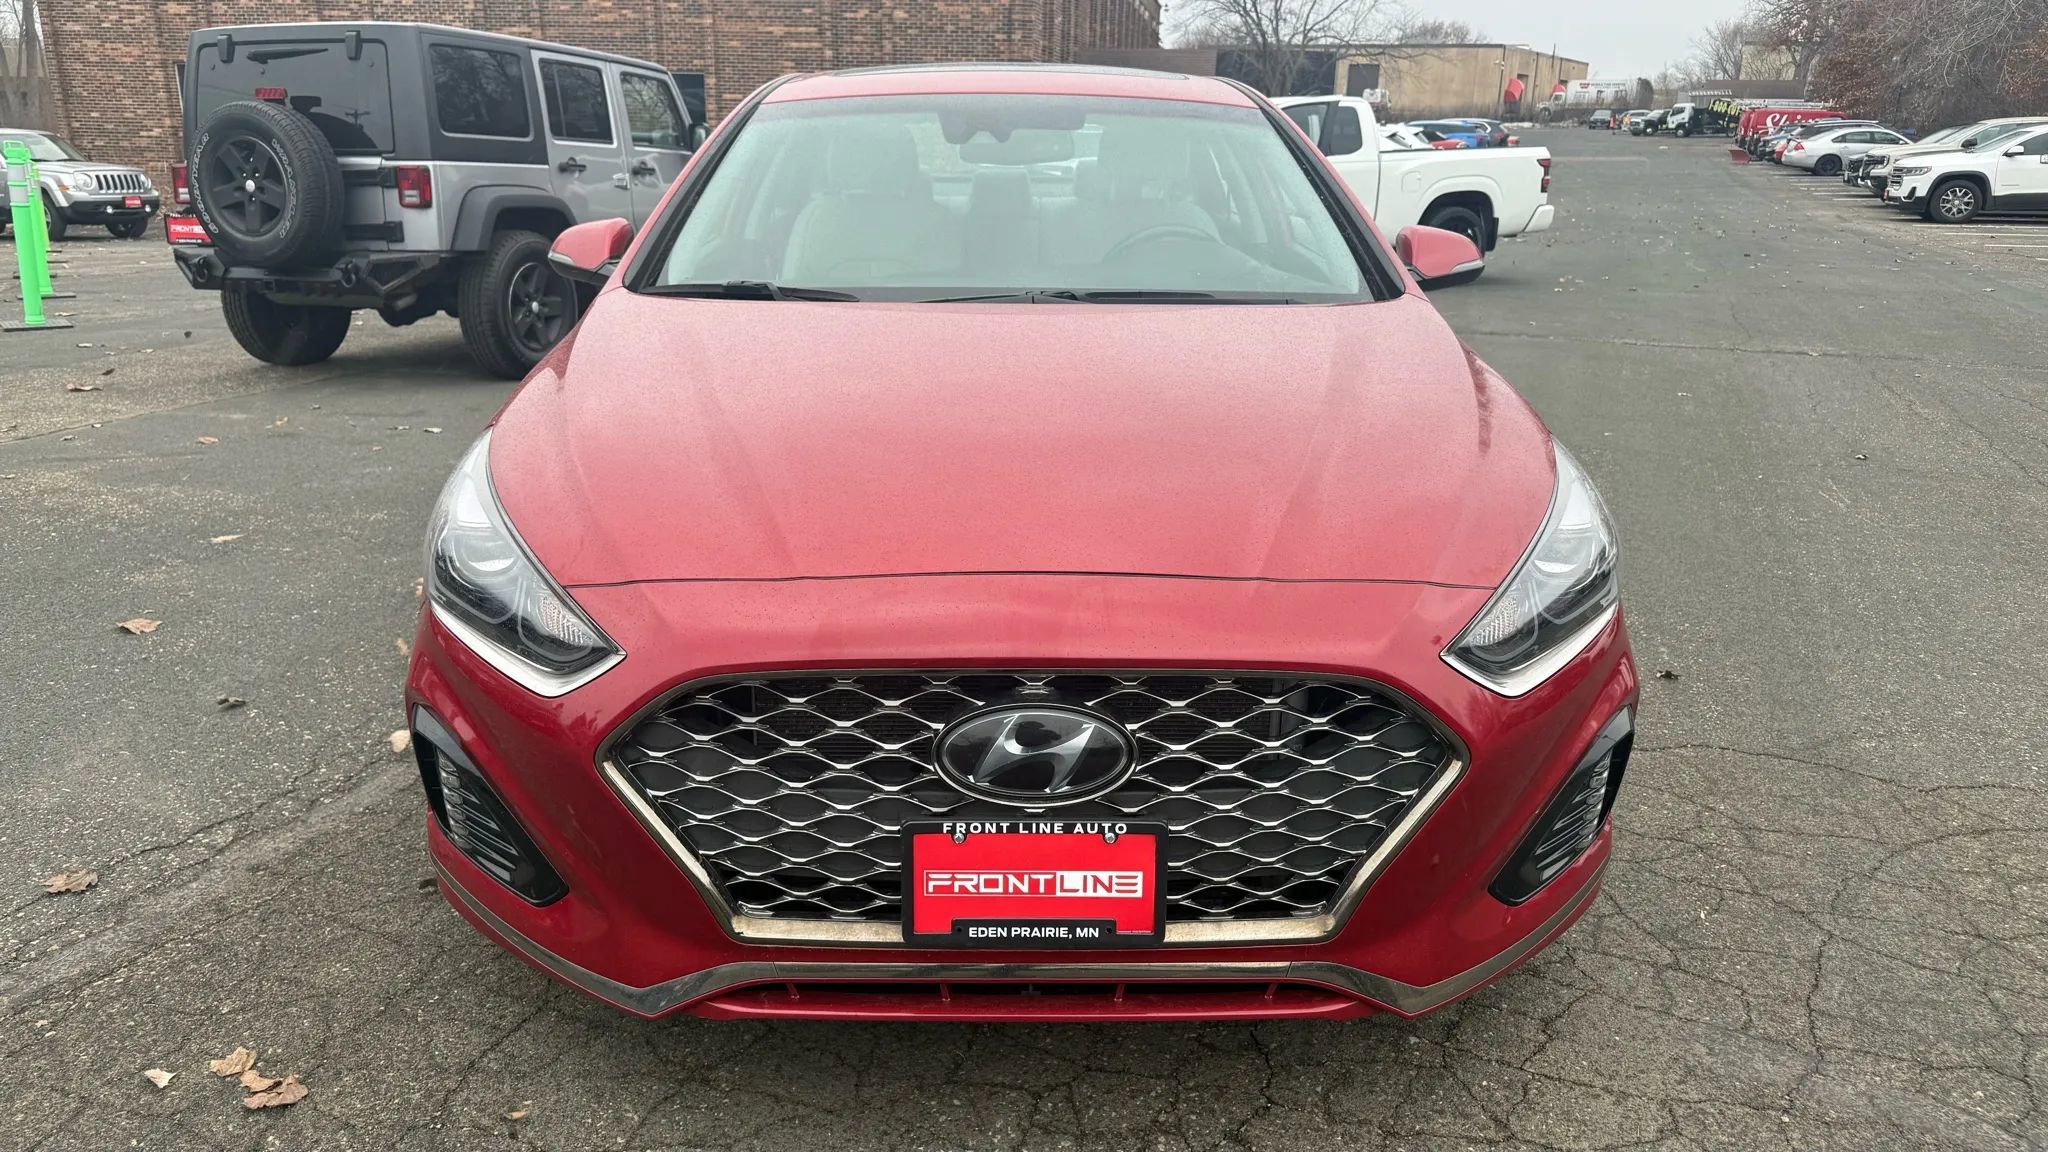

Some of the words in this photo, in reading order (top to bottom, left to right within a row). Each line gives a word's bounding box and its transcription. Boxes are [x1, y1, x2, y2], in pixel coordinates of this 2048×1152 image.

[192, 132, 219, 233] GOODYEAR
[942, 822, 1011, 834] FRONT
[1019, 822, 1064, 834] LINE
[1073, 823, 1128, 834] AUTO
[968, 927, 1008, 938] EDEN
[1010, 927, 1073, 940] PRAIRIE,
[1075, 927, 1100, 938] MN
